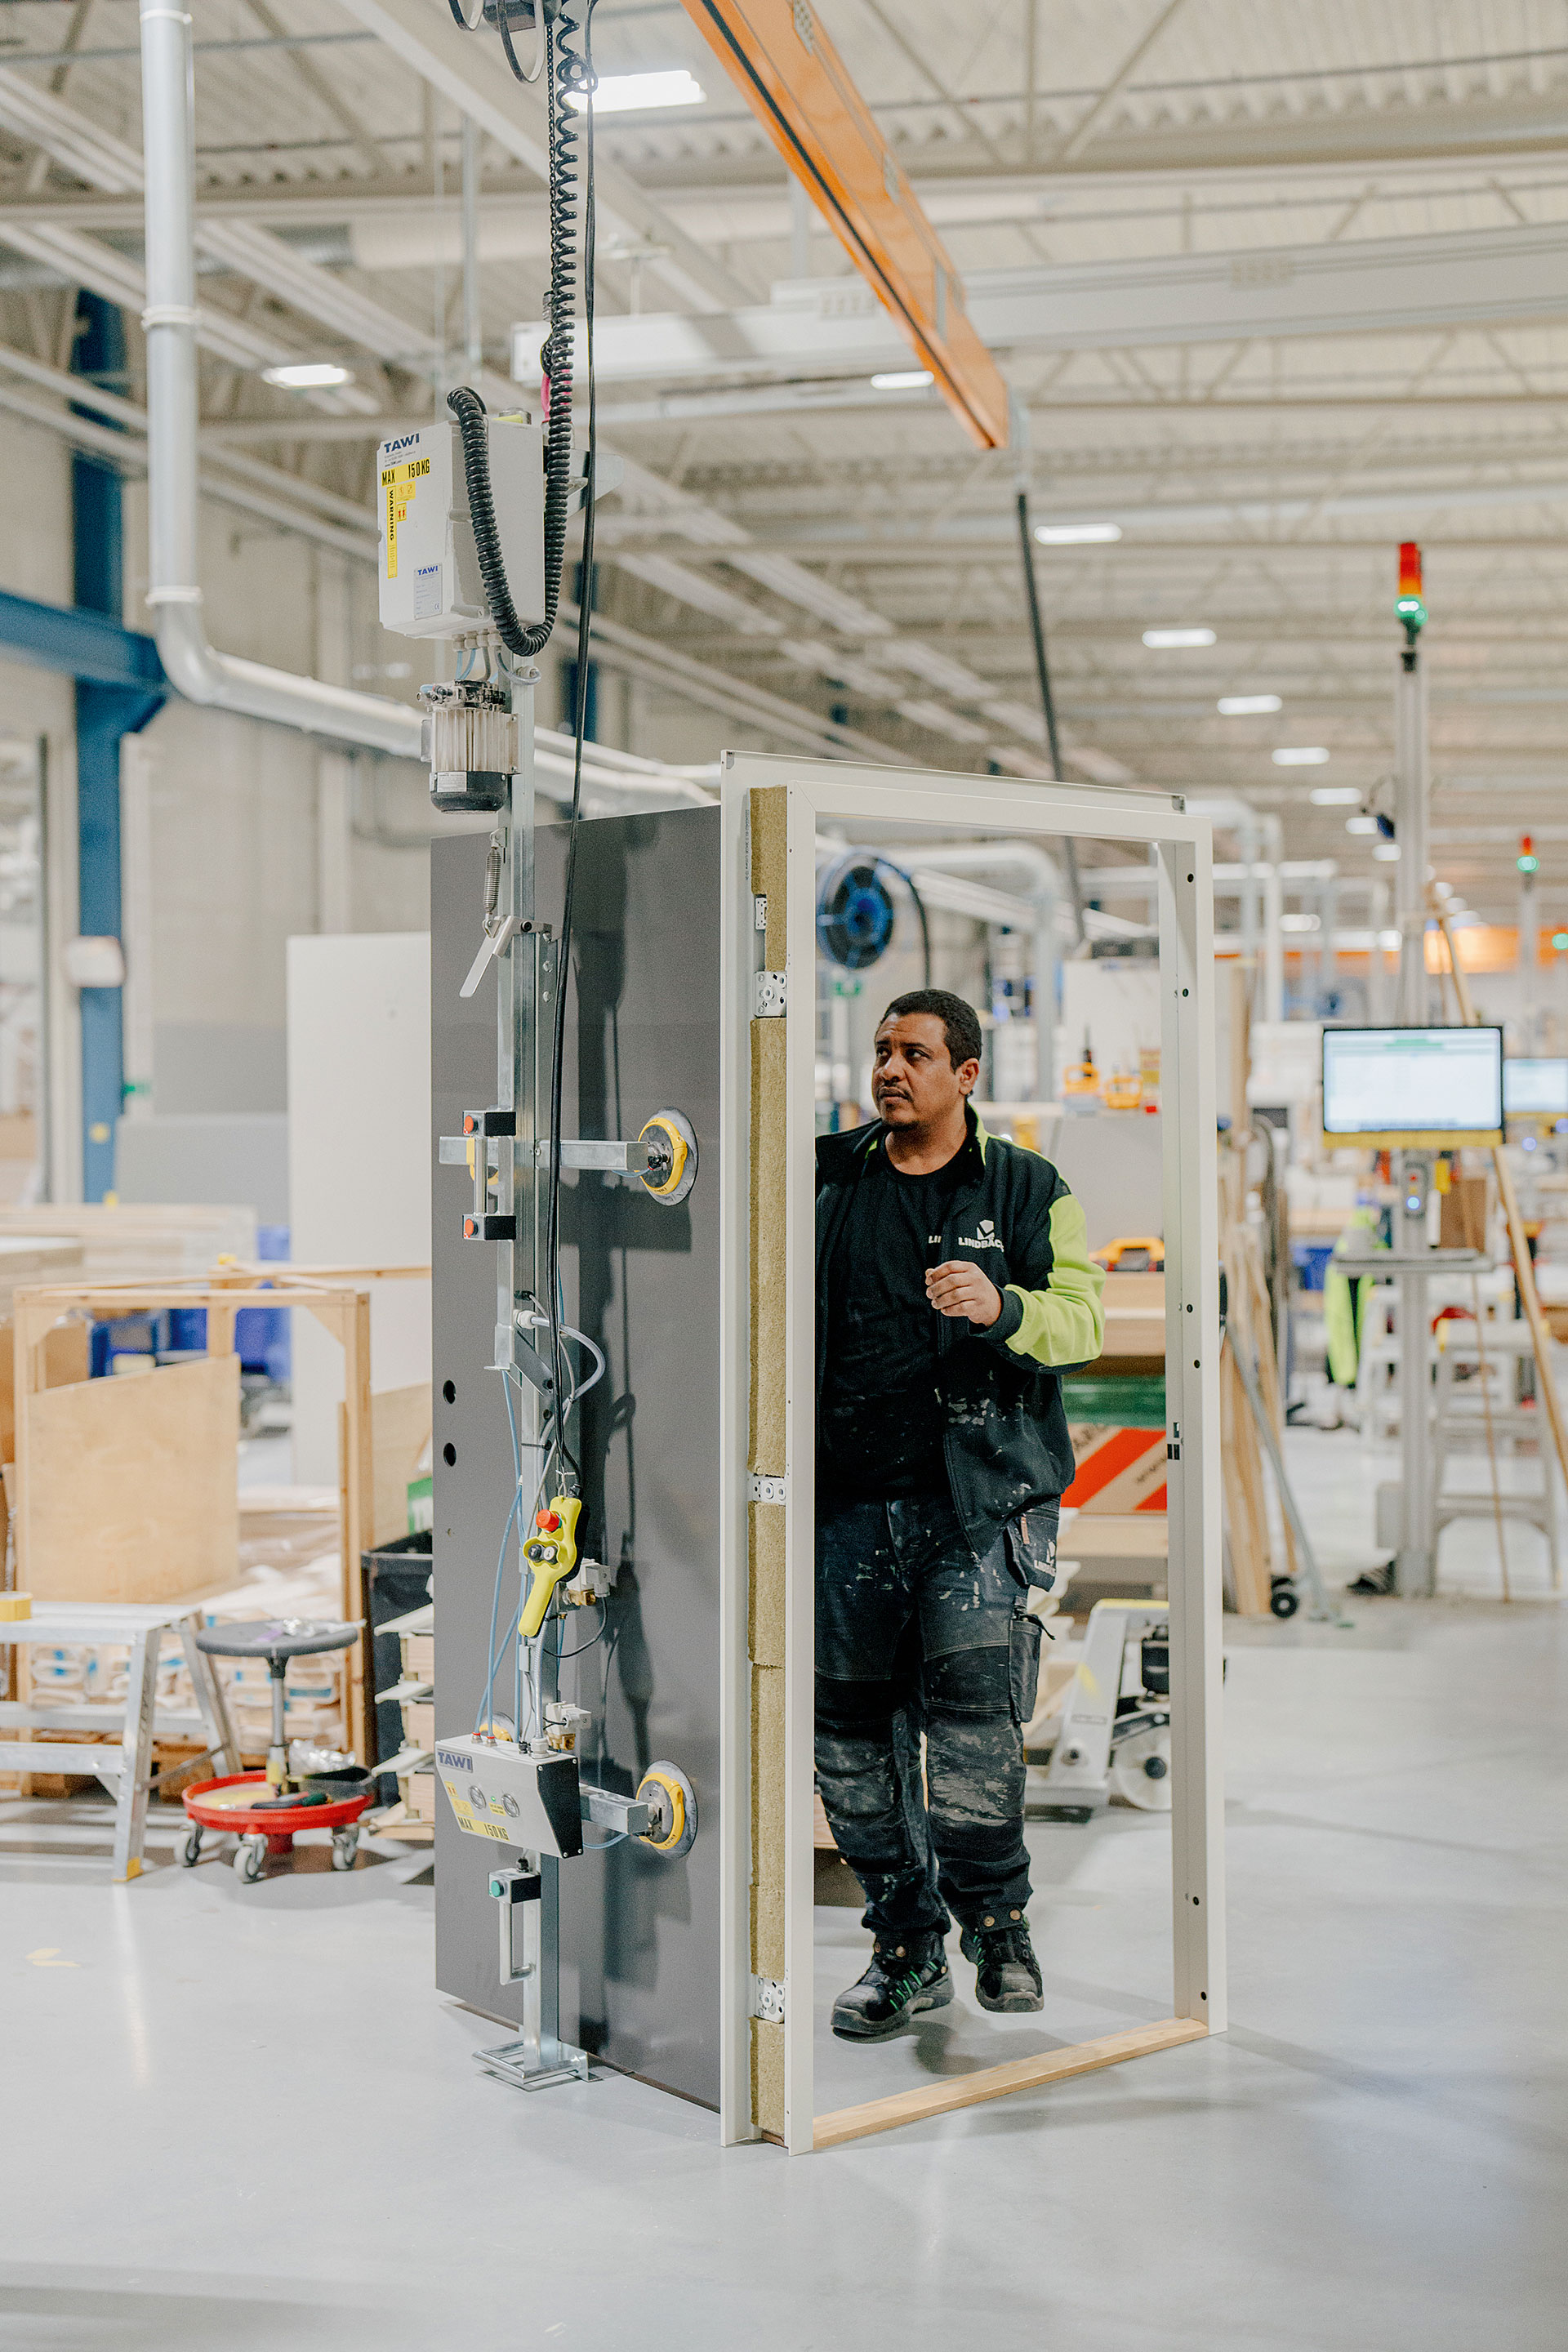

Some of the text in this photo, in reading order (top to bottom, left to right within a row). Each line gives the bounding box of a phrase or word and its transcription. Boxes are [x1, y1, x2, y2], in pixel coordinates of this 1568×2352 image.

[384, 433, 420, 453] TAWI
[381, 470, 395, 486] MAX
[417, 565, 439, 576] TAWI
[438, 1752, 471, 1770] TAWI
[457, 1816, 474, 1830] MAX
